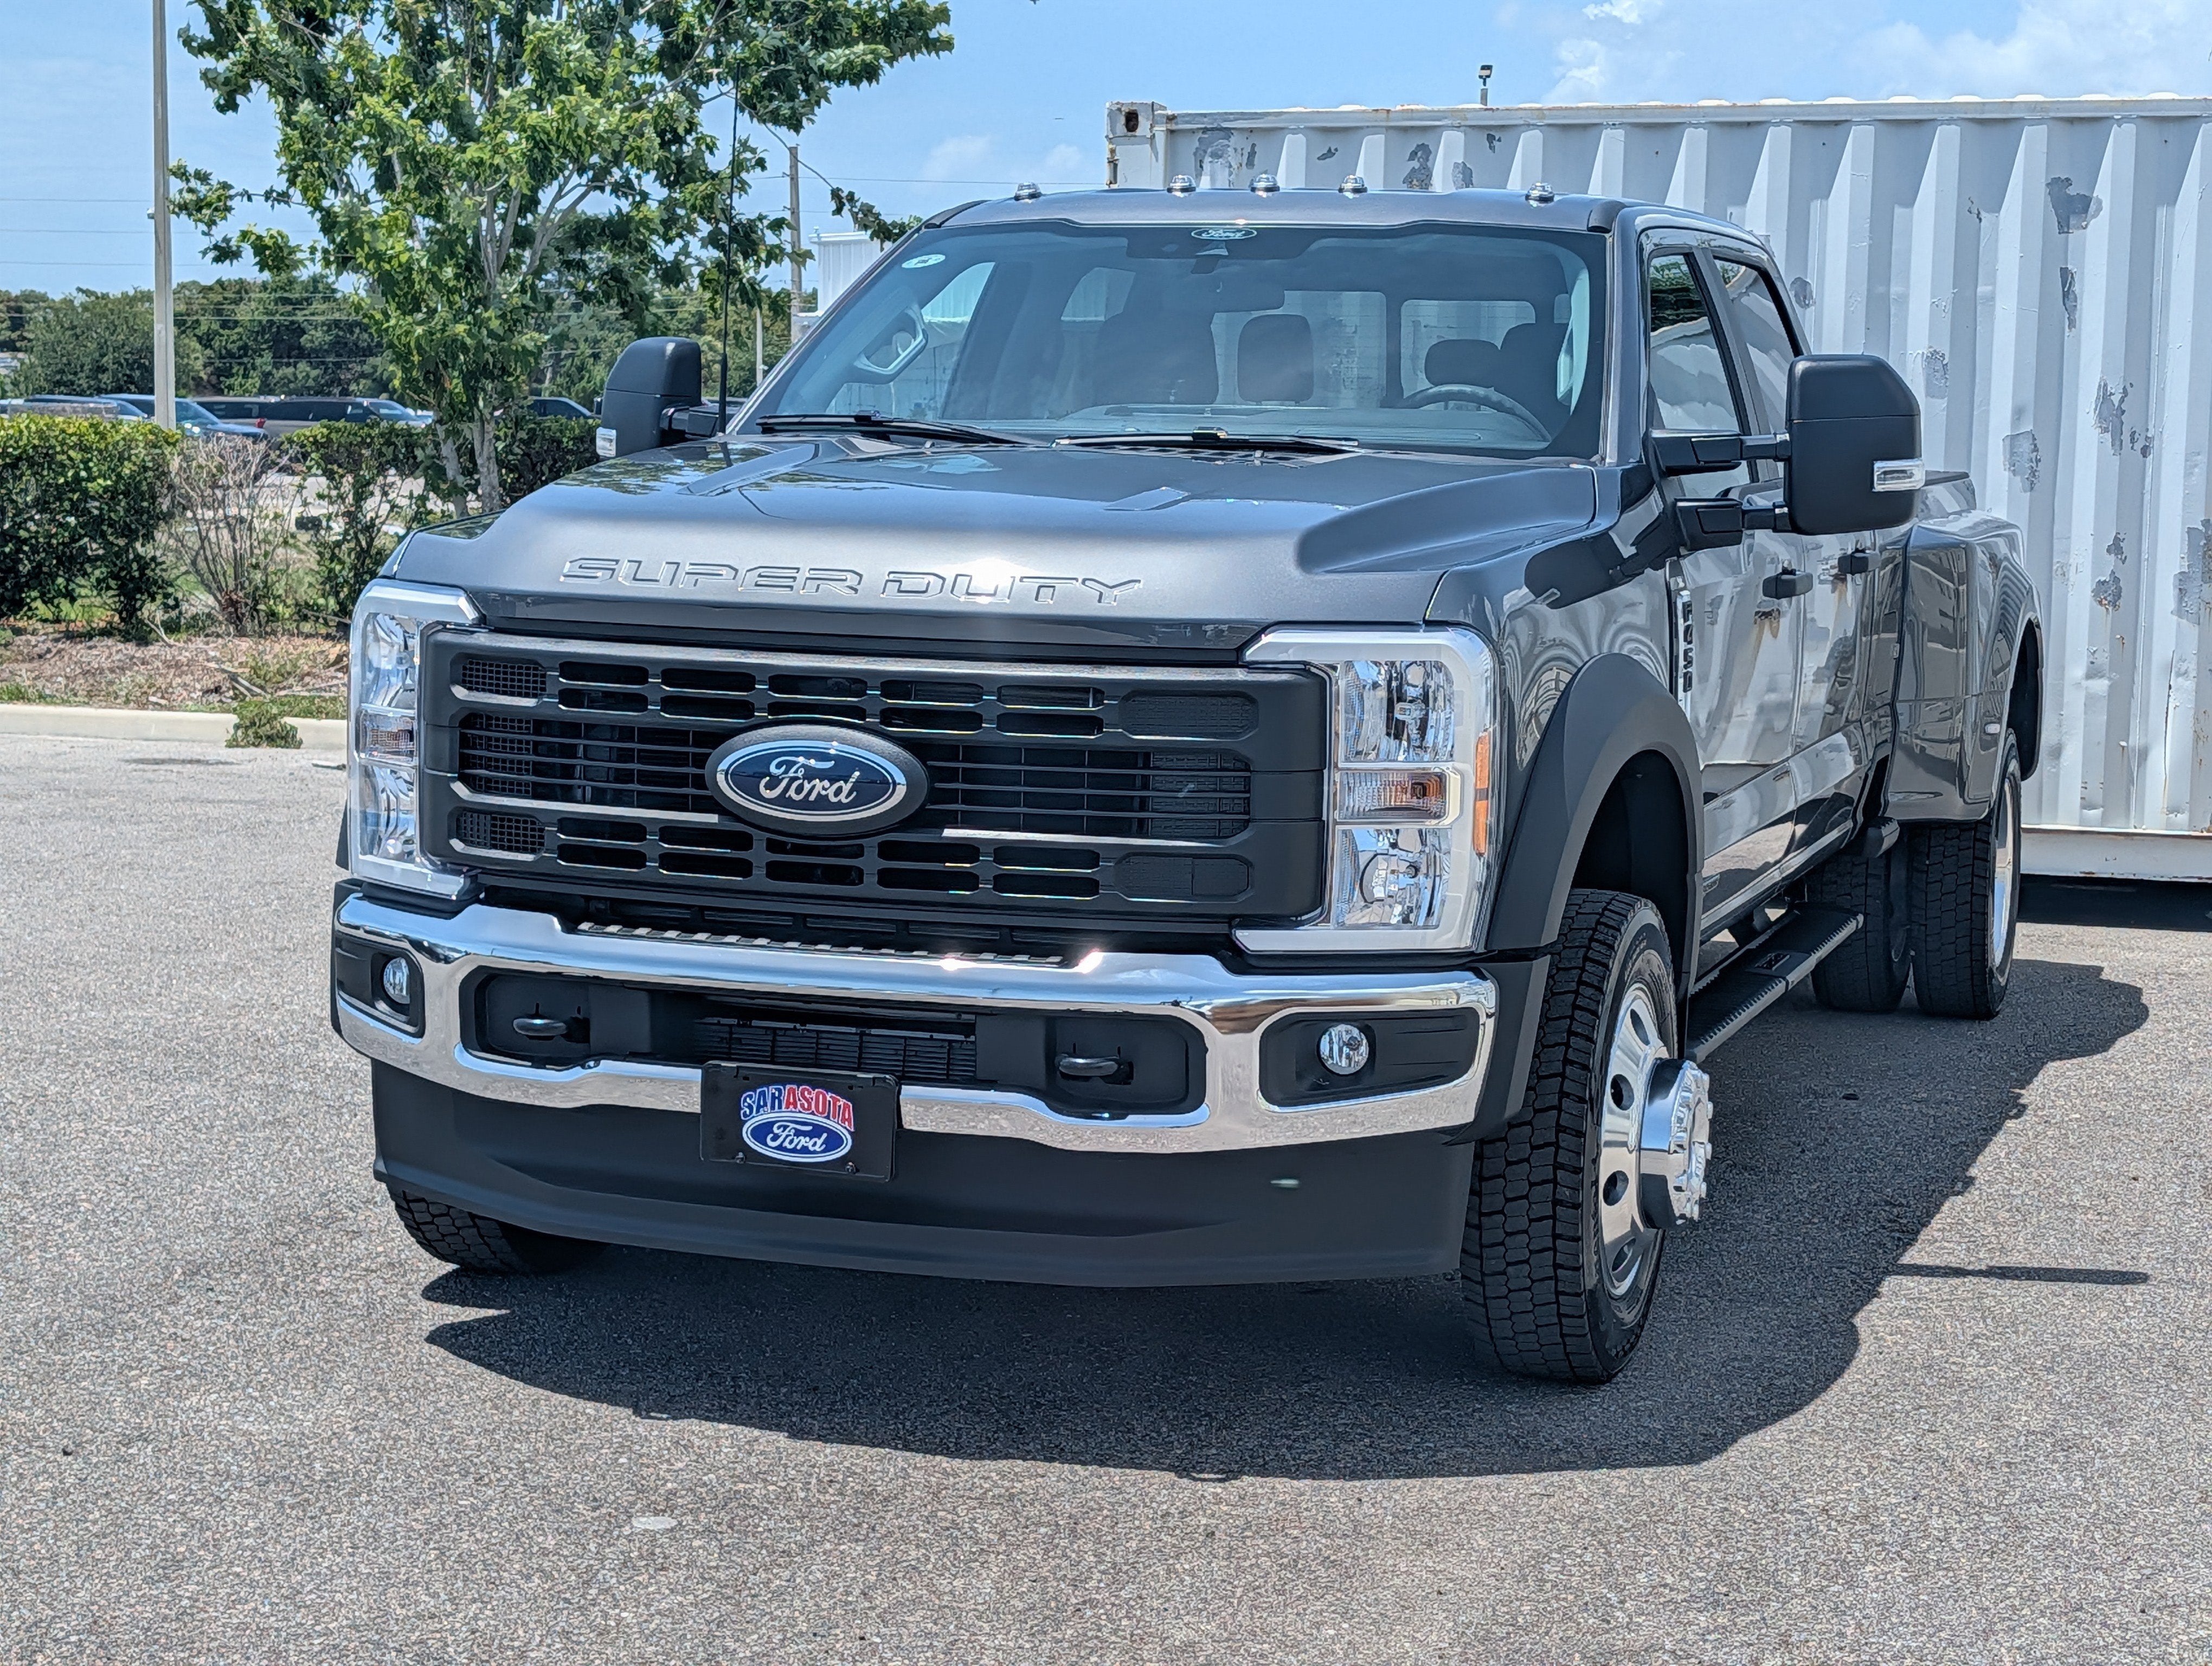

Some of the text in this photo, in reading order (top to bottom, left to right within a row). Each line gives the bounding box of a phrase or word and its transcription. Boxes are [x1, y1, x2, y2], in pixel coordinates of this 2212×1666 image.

[1201, 228, 1246, 238] Ford
[559, 558, 1143, 605] SUPER DUTY
[759, 756, 860, 803] Ford
[741, 1085, 855, 1132] SARASOTA
[766, 1122, 828, 1152] Ford
